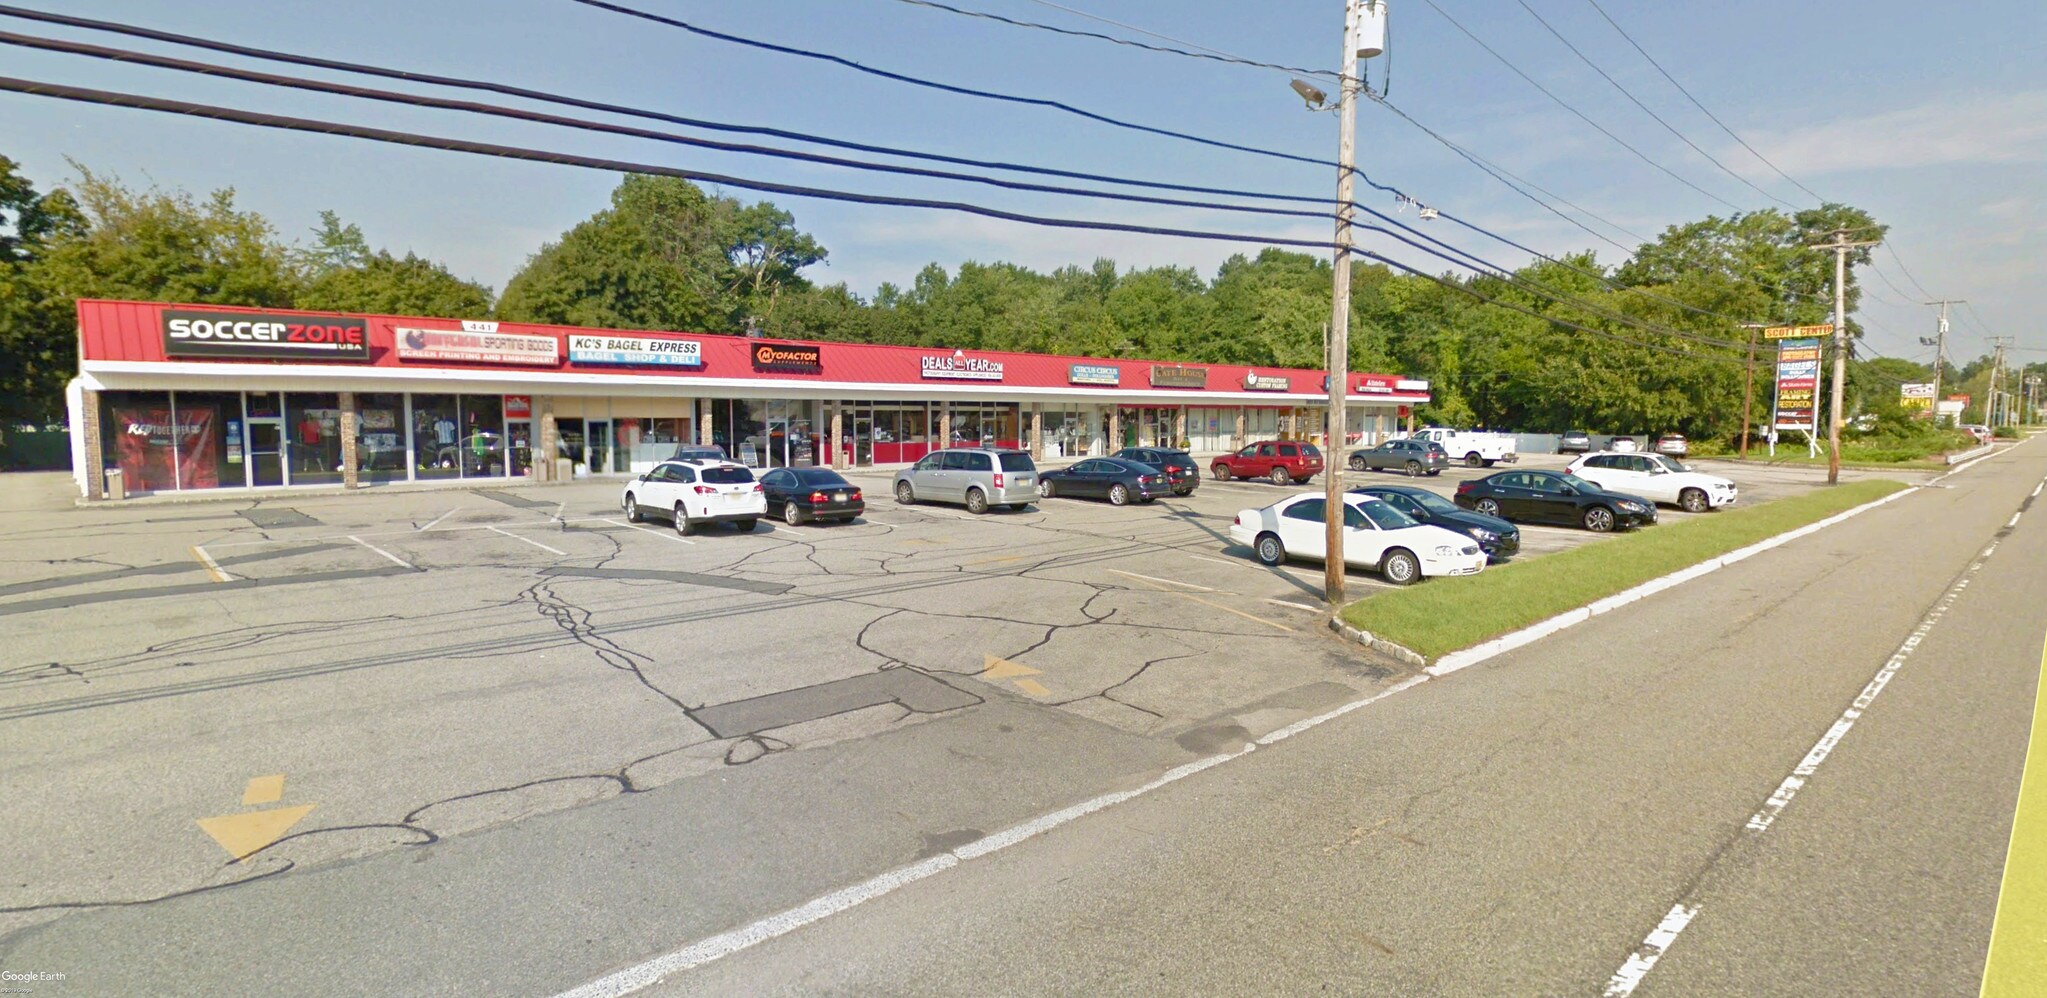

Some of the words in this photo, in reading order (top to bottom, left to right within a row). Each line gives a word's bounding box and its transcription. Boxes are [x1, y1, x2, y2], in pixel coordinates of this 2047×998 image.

[1767, 327, 1795, 337] SCOTT
[1799, 325, 1833, 336] CENTER
[484, 337, 524, 350] SPORTING
[527, 339, 554, 352] GOODS
[575, 338, 602, 349] KC'S
[607, 340, 643, 351] BAGEL
[650, 341, 697, 353] EXPRESS
[400, 350, 437, 358] SCREEN
[439, 352, 481, 361] PRINTING
[483, 353, 501, 361] AND
[502, 355, 555, 363] EMBROIDERY
[577, 351, 618, 361] BAGEL
[624, 353, 656, 362] SHOP
[672, 356, 696, 364] DELI
[761, 351, 817, 361] MYOFACTOR
[922, 356, 954, 370] DEALS
[1074, 365, 1096, 374] CIRCUS
[1097, 367, 1118, 375] CIRCUS
